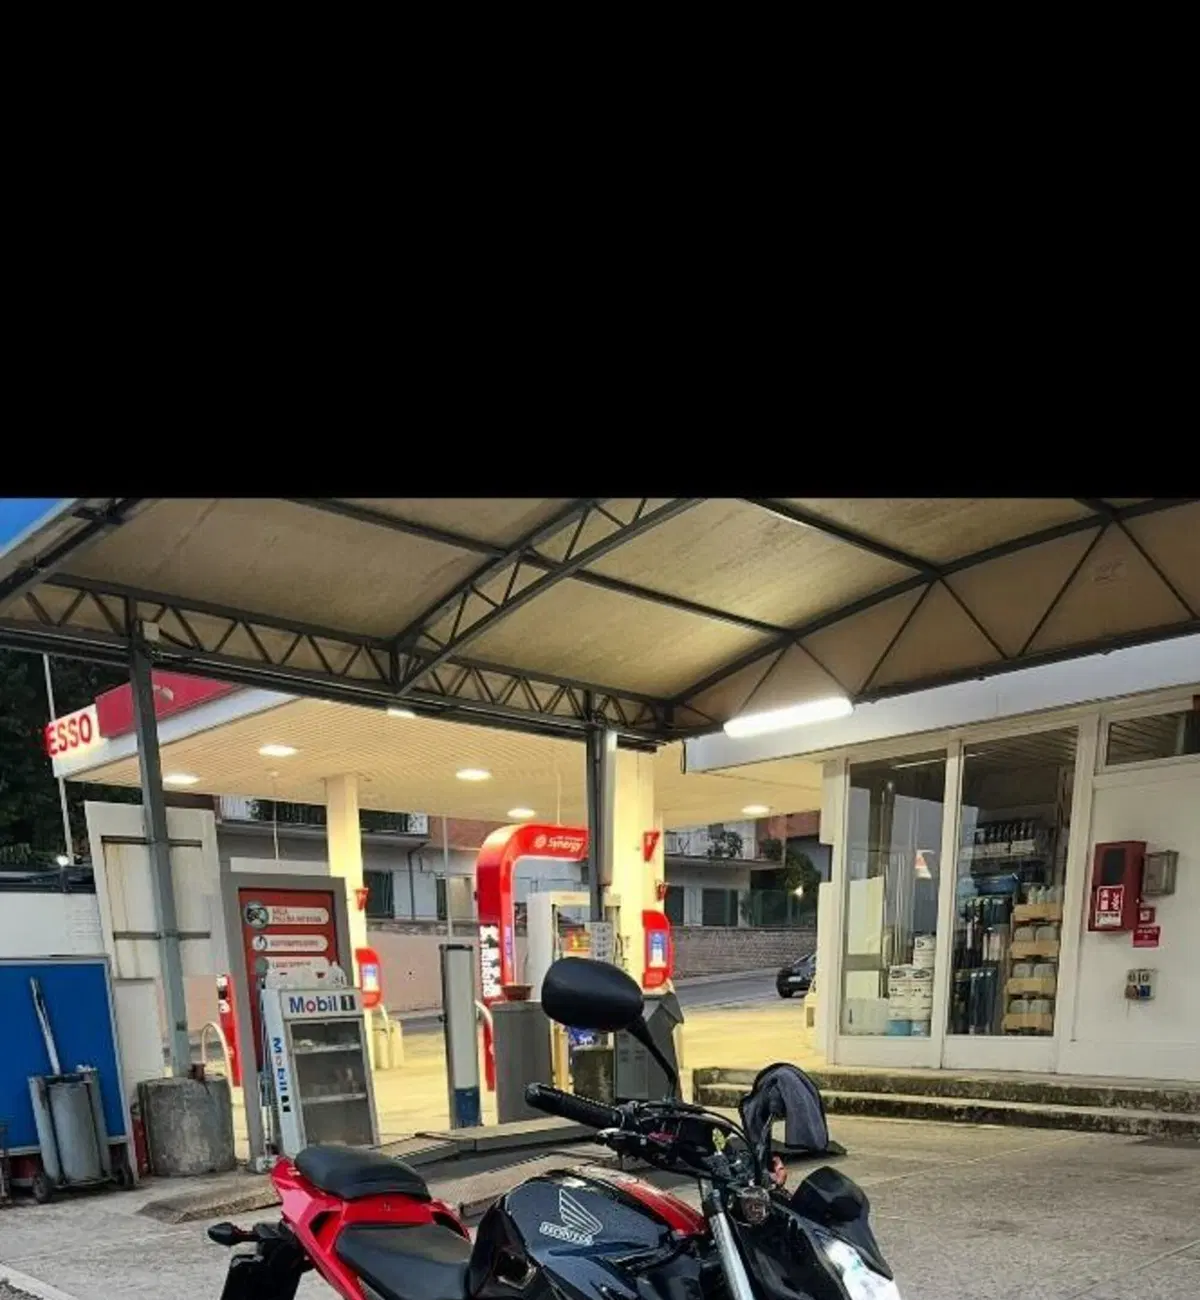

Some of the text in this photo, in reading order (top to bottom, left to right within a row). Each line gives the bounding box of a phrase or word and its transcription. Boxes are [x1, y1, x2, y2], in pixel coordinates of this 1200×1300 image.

[44, 713, 93, 755] ESSO
[289, 995, 338, 1013] Mobil
[272, 1037, 288, 1091] Mobil
[539, 1221, 595, 1246] HONDA
